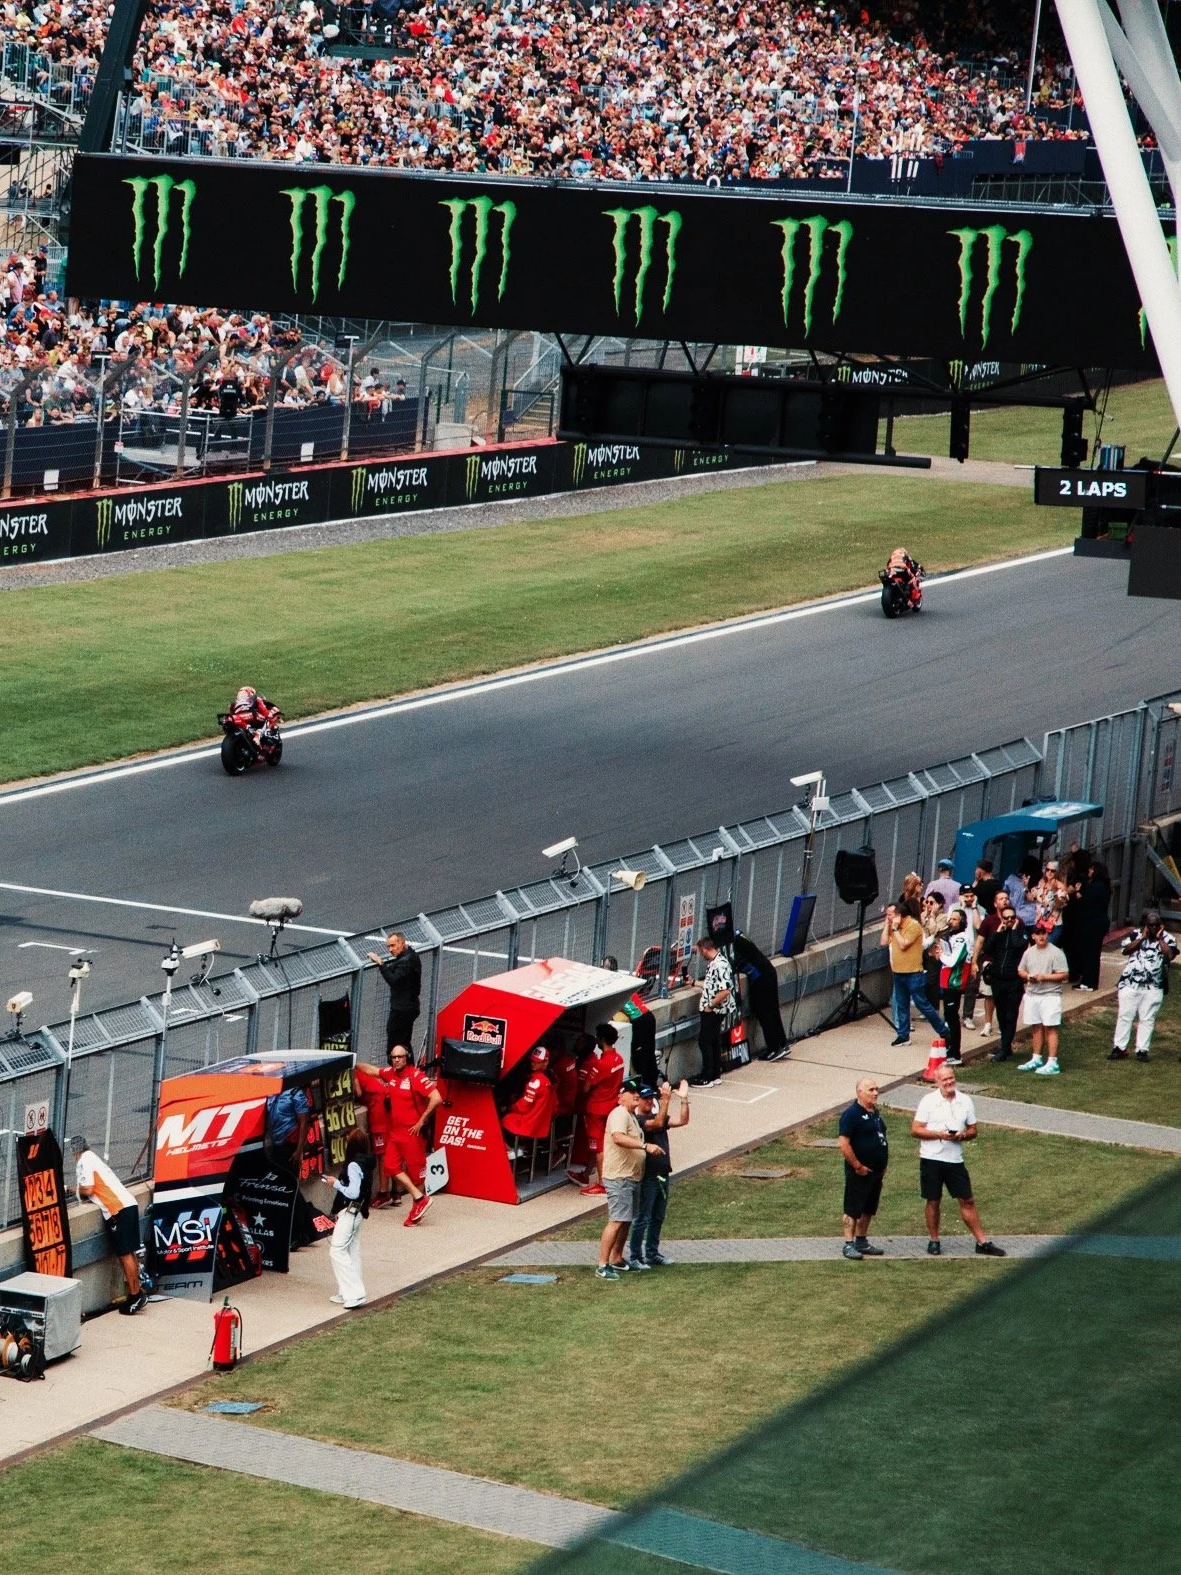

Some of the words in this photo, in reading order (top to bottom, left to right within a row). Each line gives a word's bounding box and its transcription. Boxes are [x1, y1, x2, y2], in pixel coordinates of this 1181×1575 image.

[693, 453, 730, 466] ENERGY
[481, 455, 538, 481] MONSTER
[593, 467, 632, 480] ENERGY
[367, 467, 428, 494] MONSTER
[488, 481, 529, 494] ENERGY
[245, 480, 310, 509] MONSTER
[1060, 480, 1072, 495] 2
[1077, 481, 1127, 498] LAPS
[375, 494, 419, 507] ENERGY
[115, 497, 183, 527] MONSTER
[254, 508, 300, 522] ENERGY
[124, 526, 173, 540] ENERGY
[467, 1030, 486, 1042] Red
[485, 1032, 502, 1045] Bull
[326, 1101, 355, 1132] 5678
[446, 1115, 470, 1127] GET
[157, 1098, 266, 1150] MT
[443, 1126, 460, 1136] ON
[461, 1128, 484, 1139] THE
[166, 1138, 232, 1156] HELMETS
[440, 1135, 466, 1147] GAS!
[430, 1164, 445, 1175] 3
[242, 1195, 264, 1205] Printing
[264, 1198, 289, 1208] Emotions
[156, 1280, 203, 1292] TEAM
